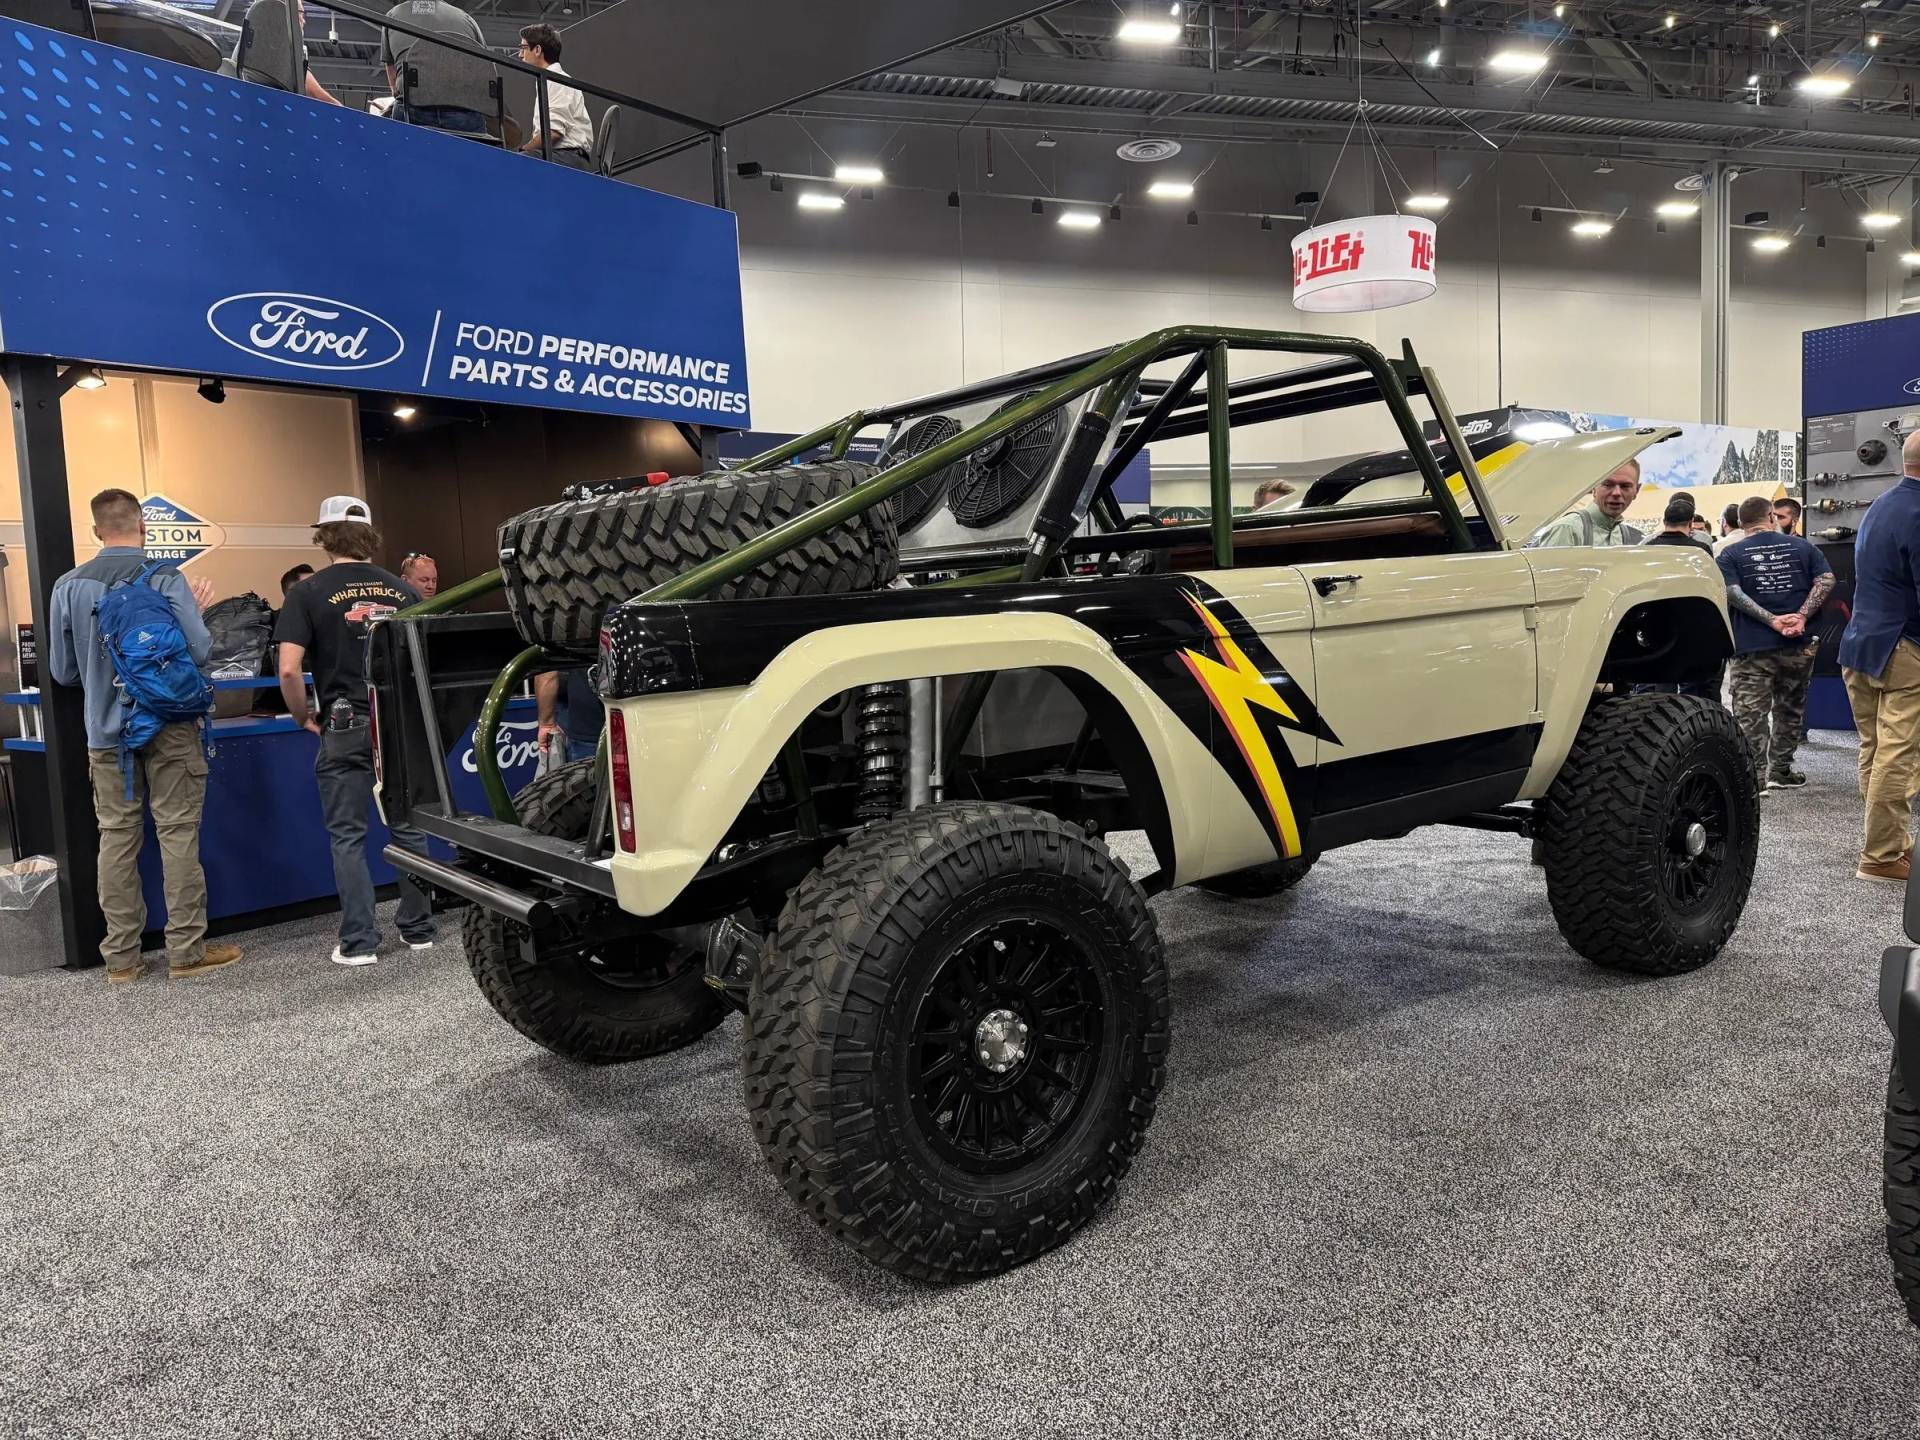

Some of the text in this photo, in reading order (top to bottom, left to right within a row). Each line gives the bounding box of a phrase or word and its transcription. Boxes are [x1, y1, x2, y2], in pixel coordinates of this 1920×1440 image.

[250, 301, 369, 360] Ford
[456, 322, 730, 384] FORD PERFORMANCE
[449, 355, 747, 414] PARTS & ACCESSORIES
[1781, 458, 1794, 468] GO
[142, 506, 177, 521] Ford
[146, 529, 202, 542] STOM
[146, 550, 187, 559] ARAGE
[328, 588, 358, 605] WHAT
[359, 588, 368, 597] A
[461, 721, 541, 773] For
